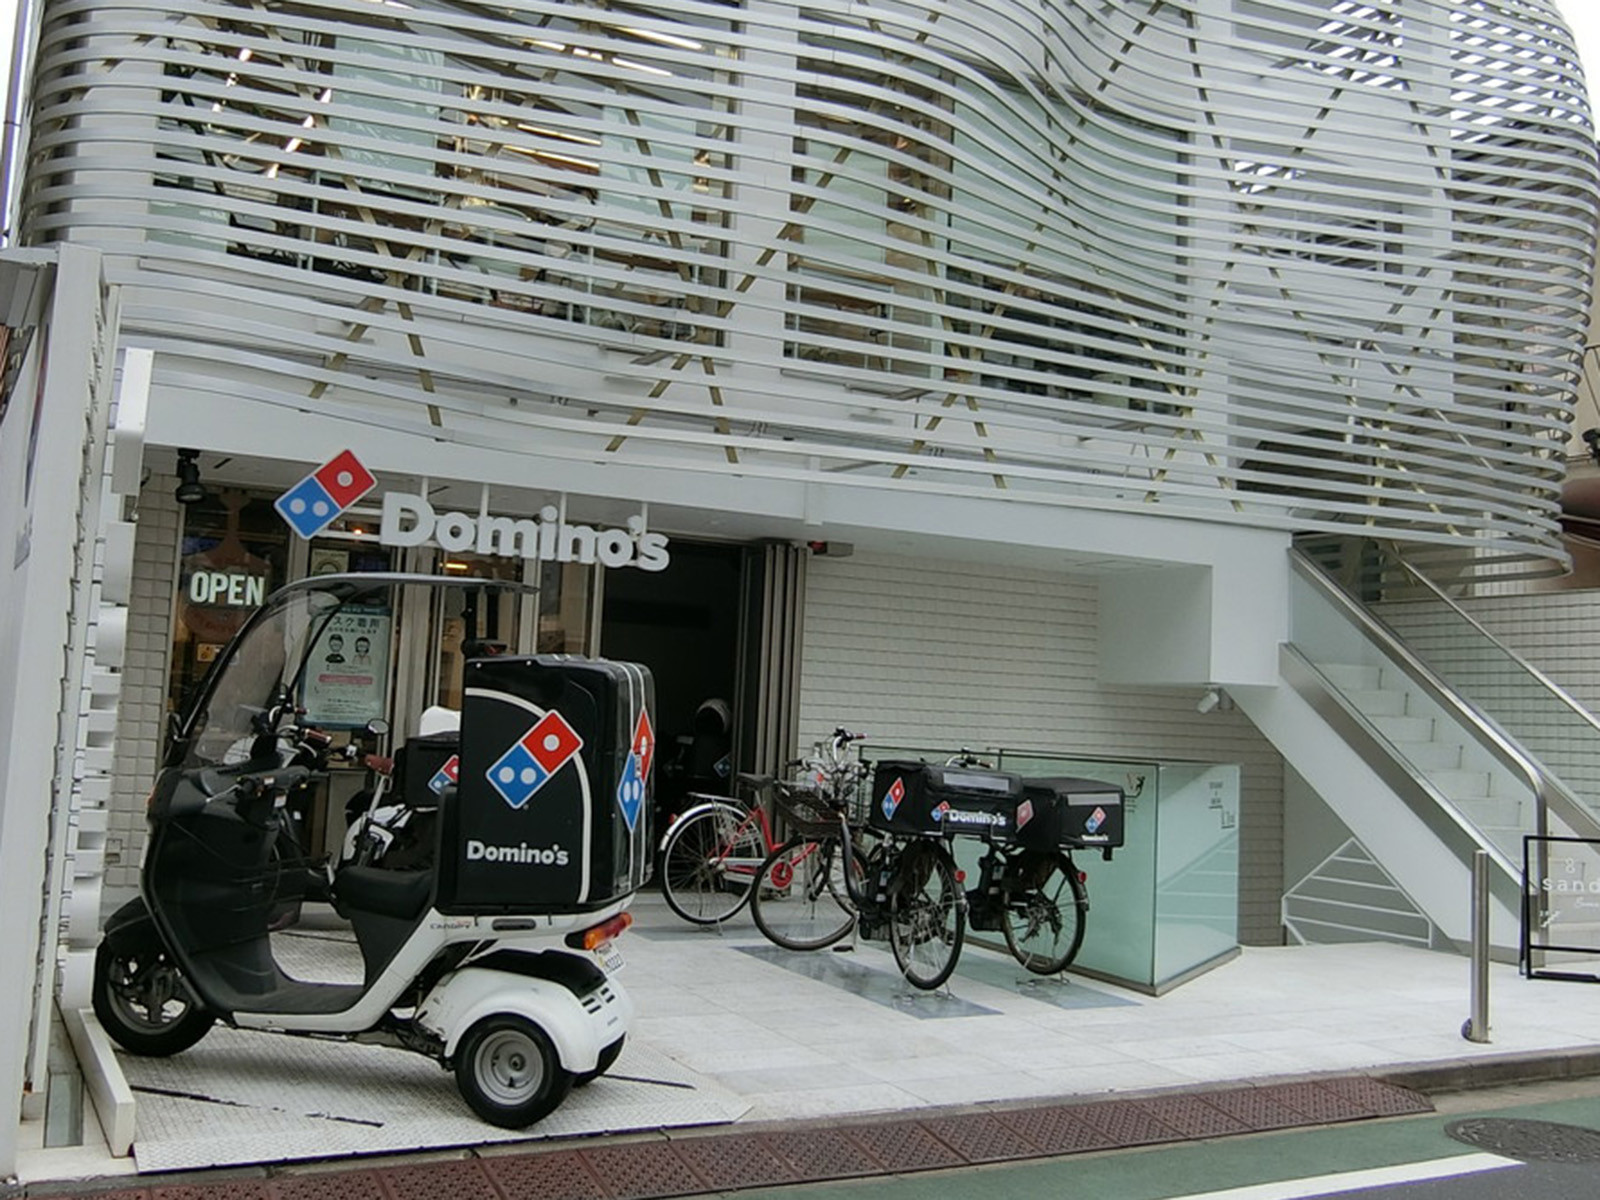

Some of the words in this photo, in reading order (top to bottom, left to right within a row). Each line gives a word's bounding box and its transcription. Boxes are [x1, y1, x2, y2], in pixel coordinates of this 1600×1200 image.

[380, 490, 670, 572] Domino's
[190, 571, 265, 606] OPEN
[466, 840, 569, 865] Domino's
